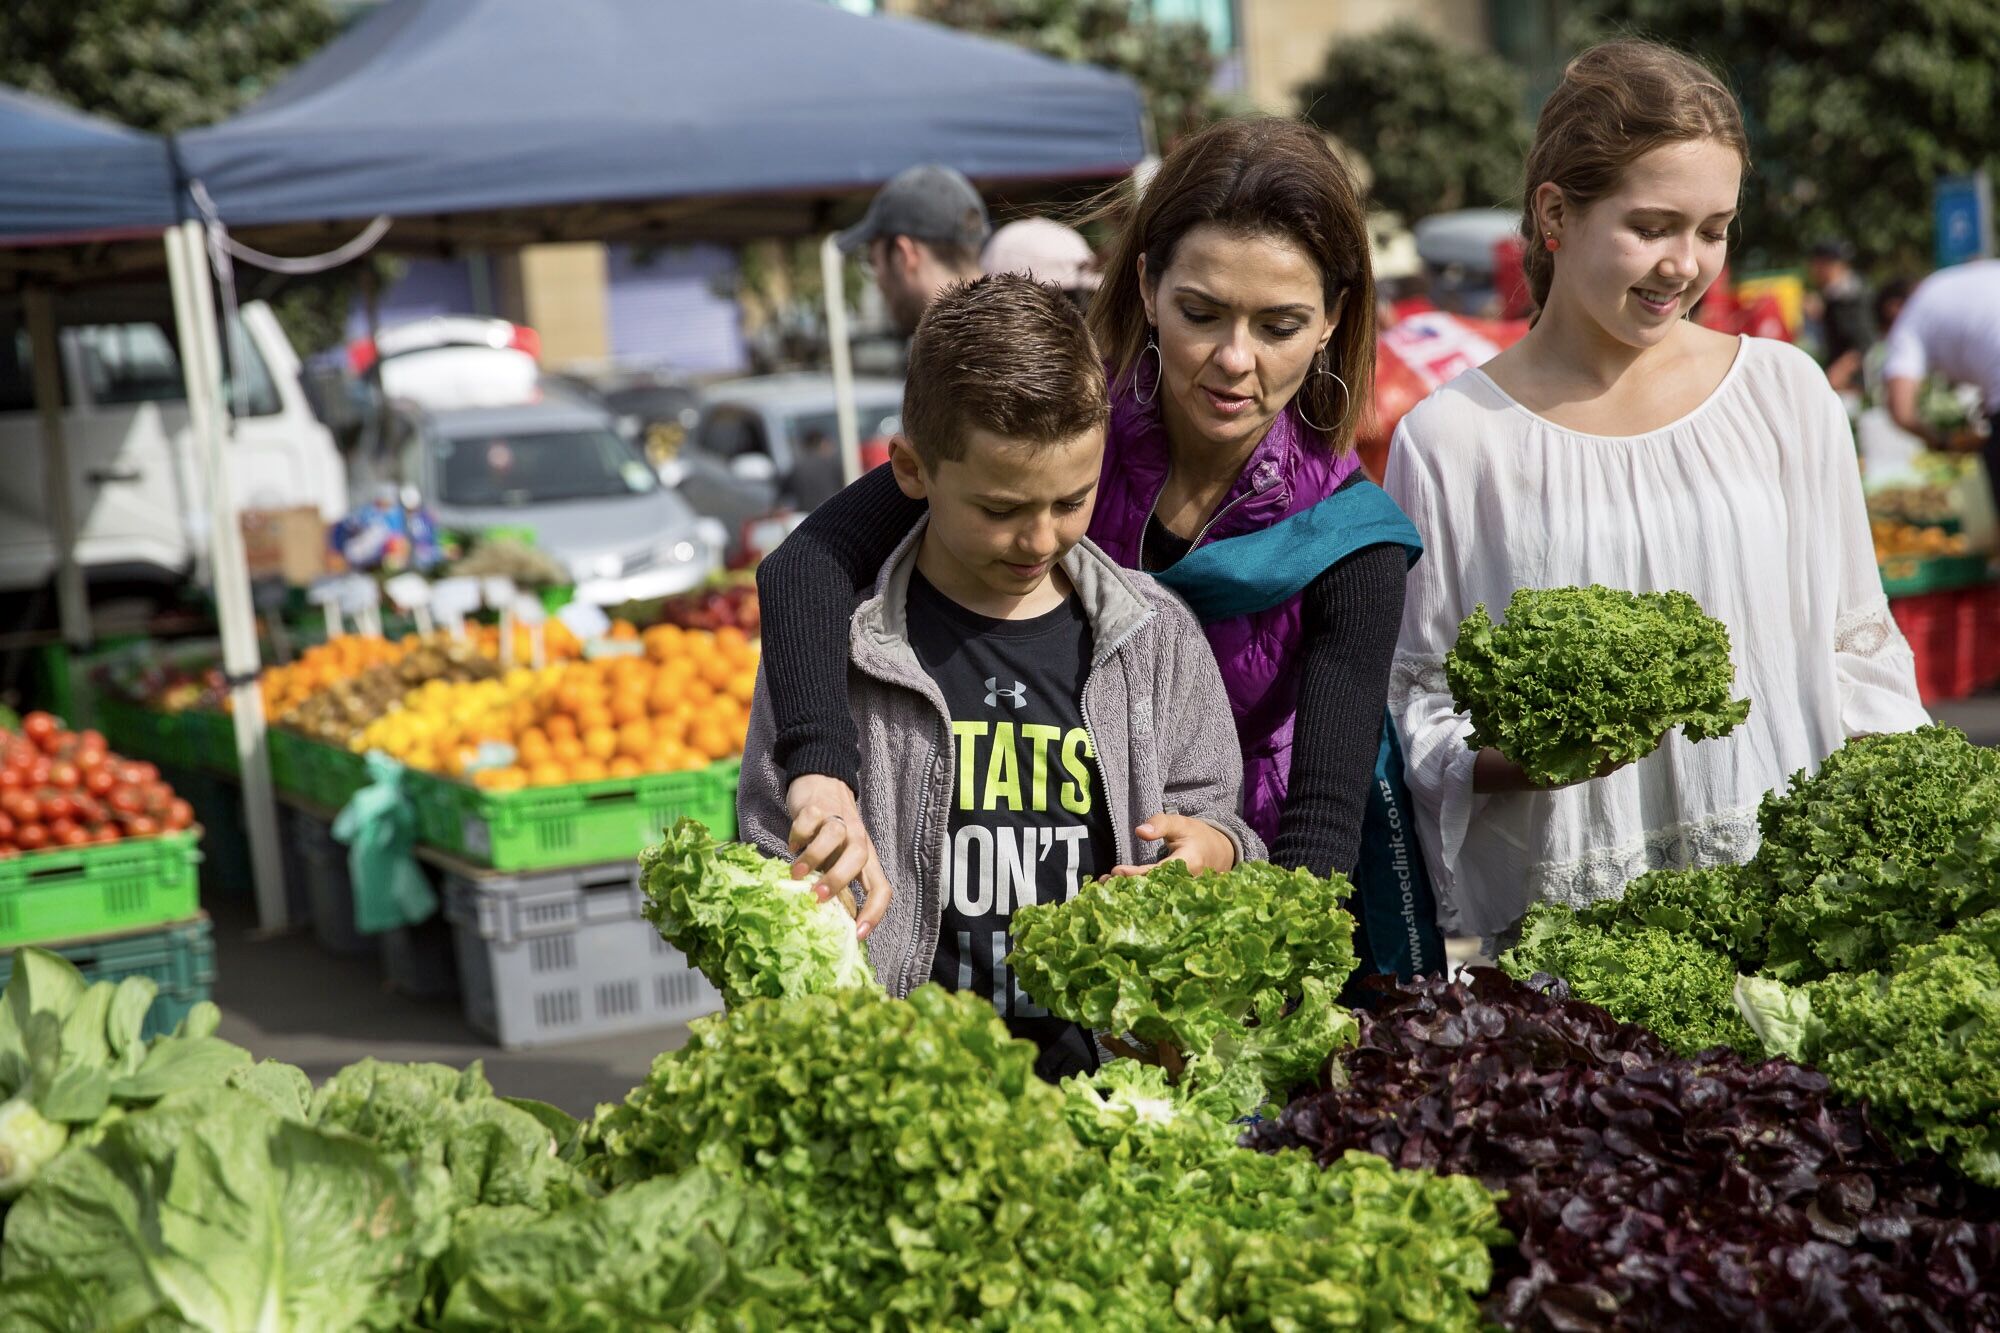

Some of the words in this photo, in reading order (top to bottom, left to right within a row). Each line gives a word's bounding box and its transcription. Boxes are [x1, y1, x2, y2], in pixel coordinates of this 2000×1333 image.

[1130, 711, 1154, 725] ORT
[1134, 699, 1154, 714] TH
[951, 720, 1096, 815] TATS
[1379, 779, 1424, 972] www.shoeclinic.co.nz
